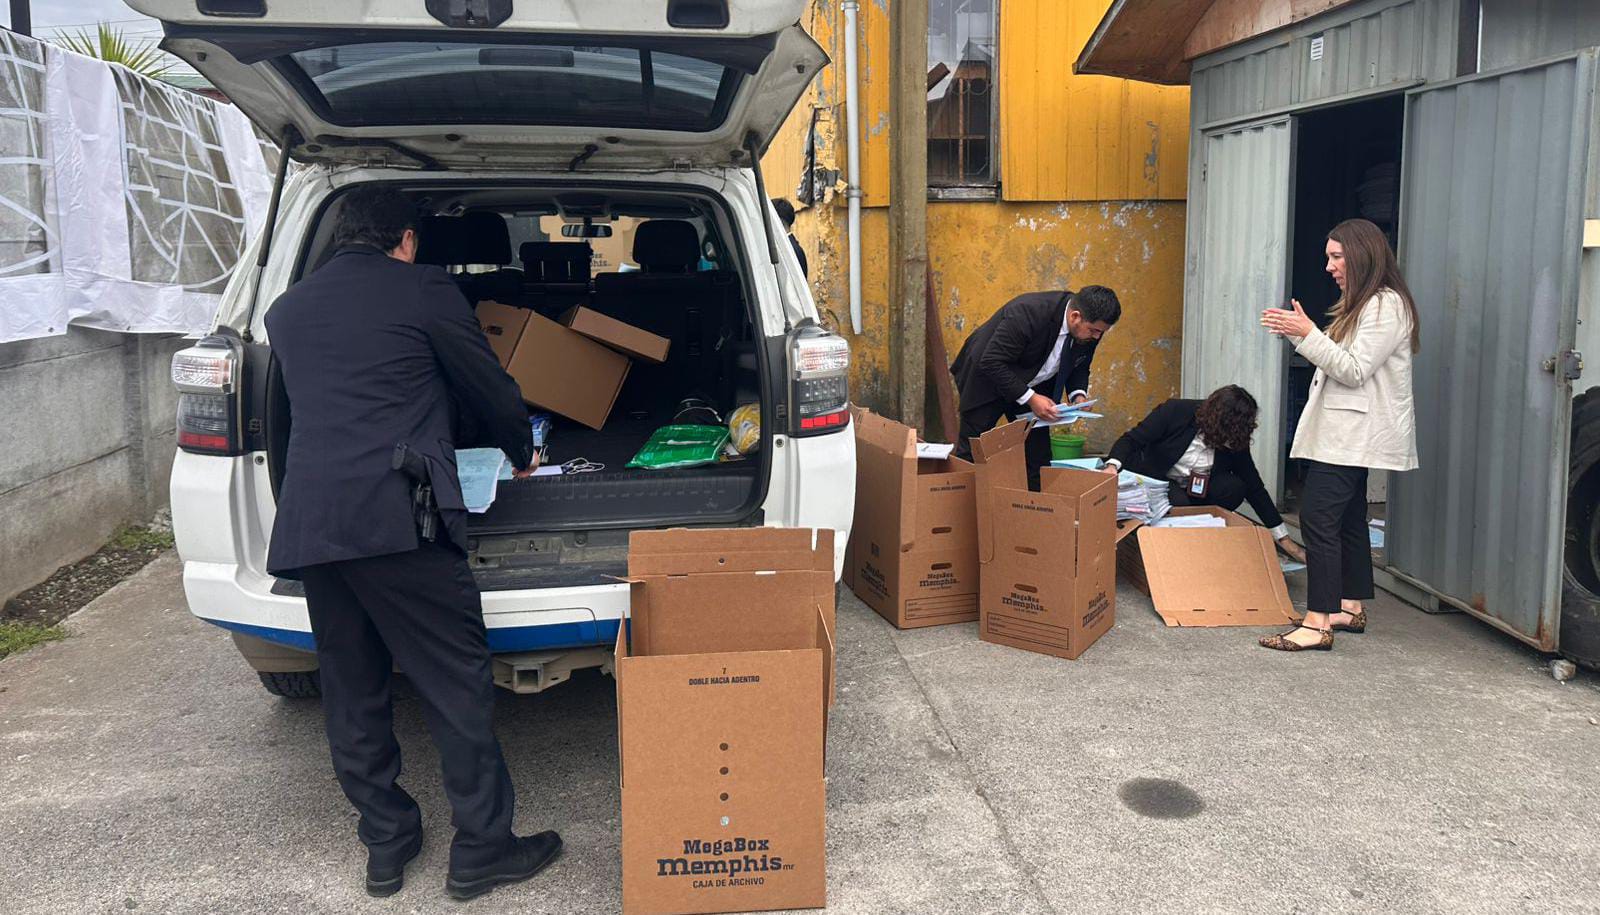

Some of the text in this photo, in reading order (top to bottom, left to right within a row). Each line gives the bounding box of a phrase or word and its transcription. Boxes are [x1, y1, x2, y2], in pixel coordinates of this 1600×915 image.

[689, 675, 760, 686] DOBLE HACIA ADENTRO
[683, 837, 770, 856] MegaBox
[692, 877, 765, 889] CAJA DE ARCHIVO
